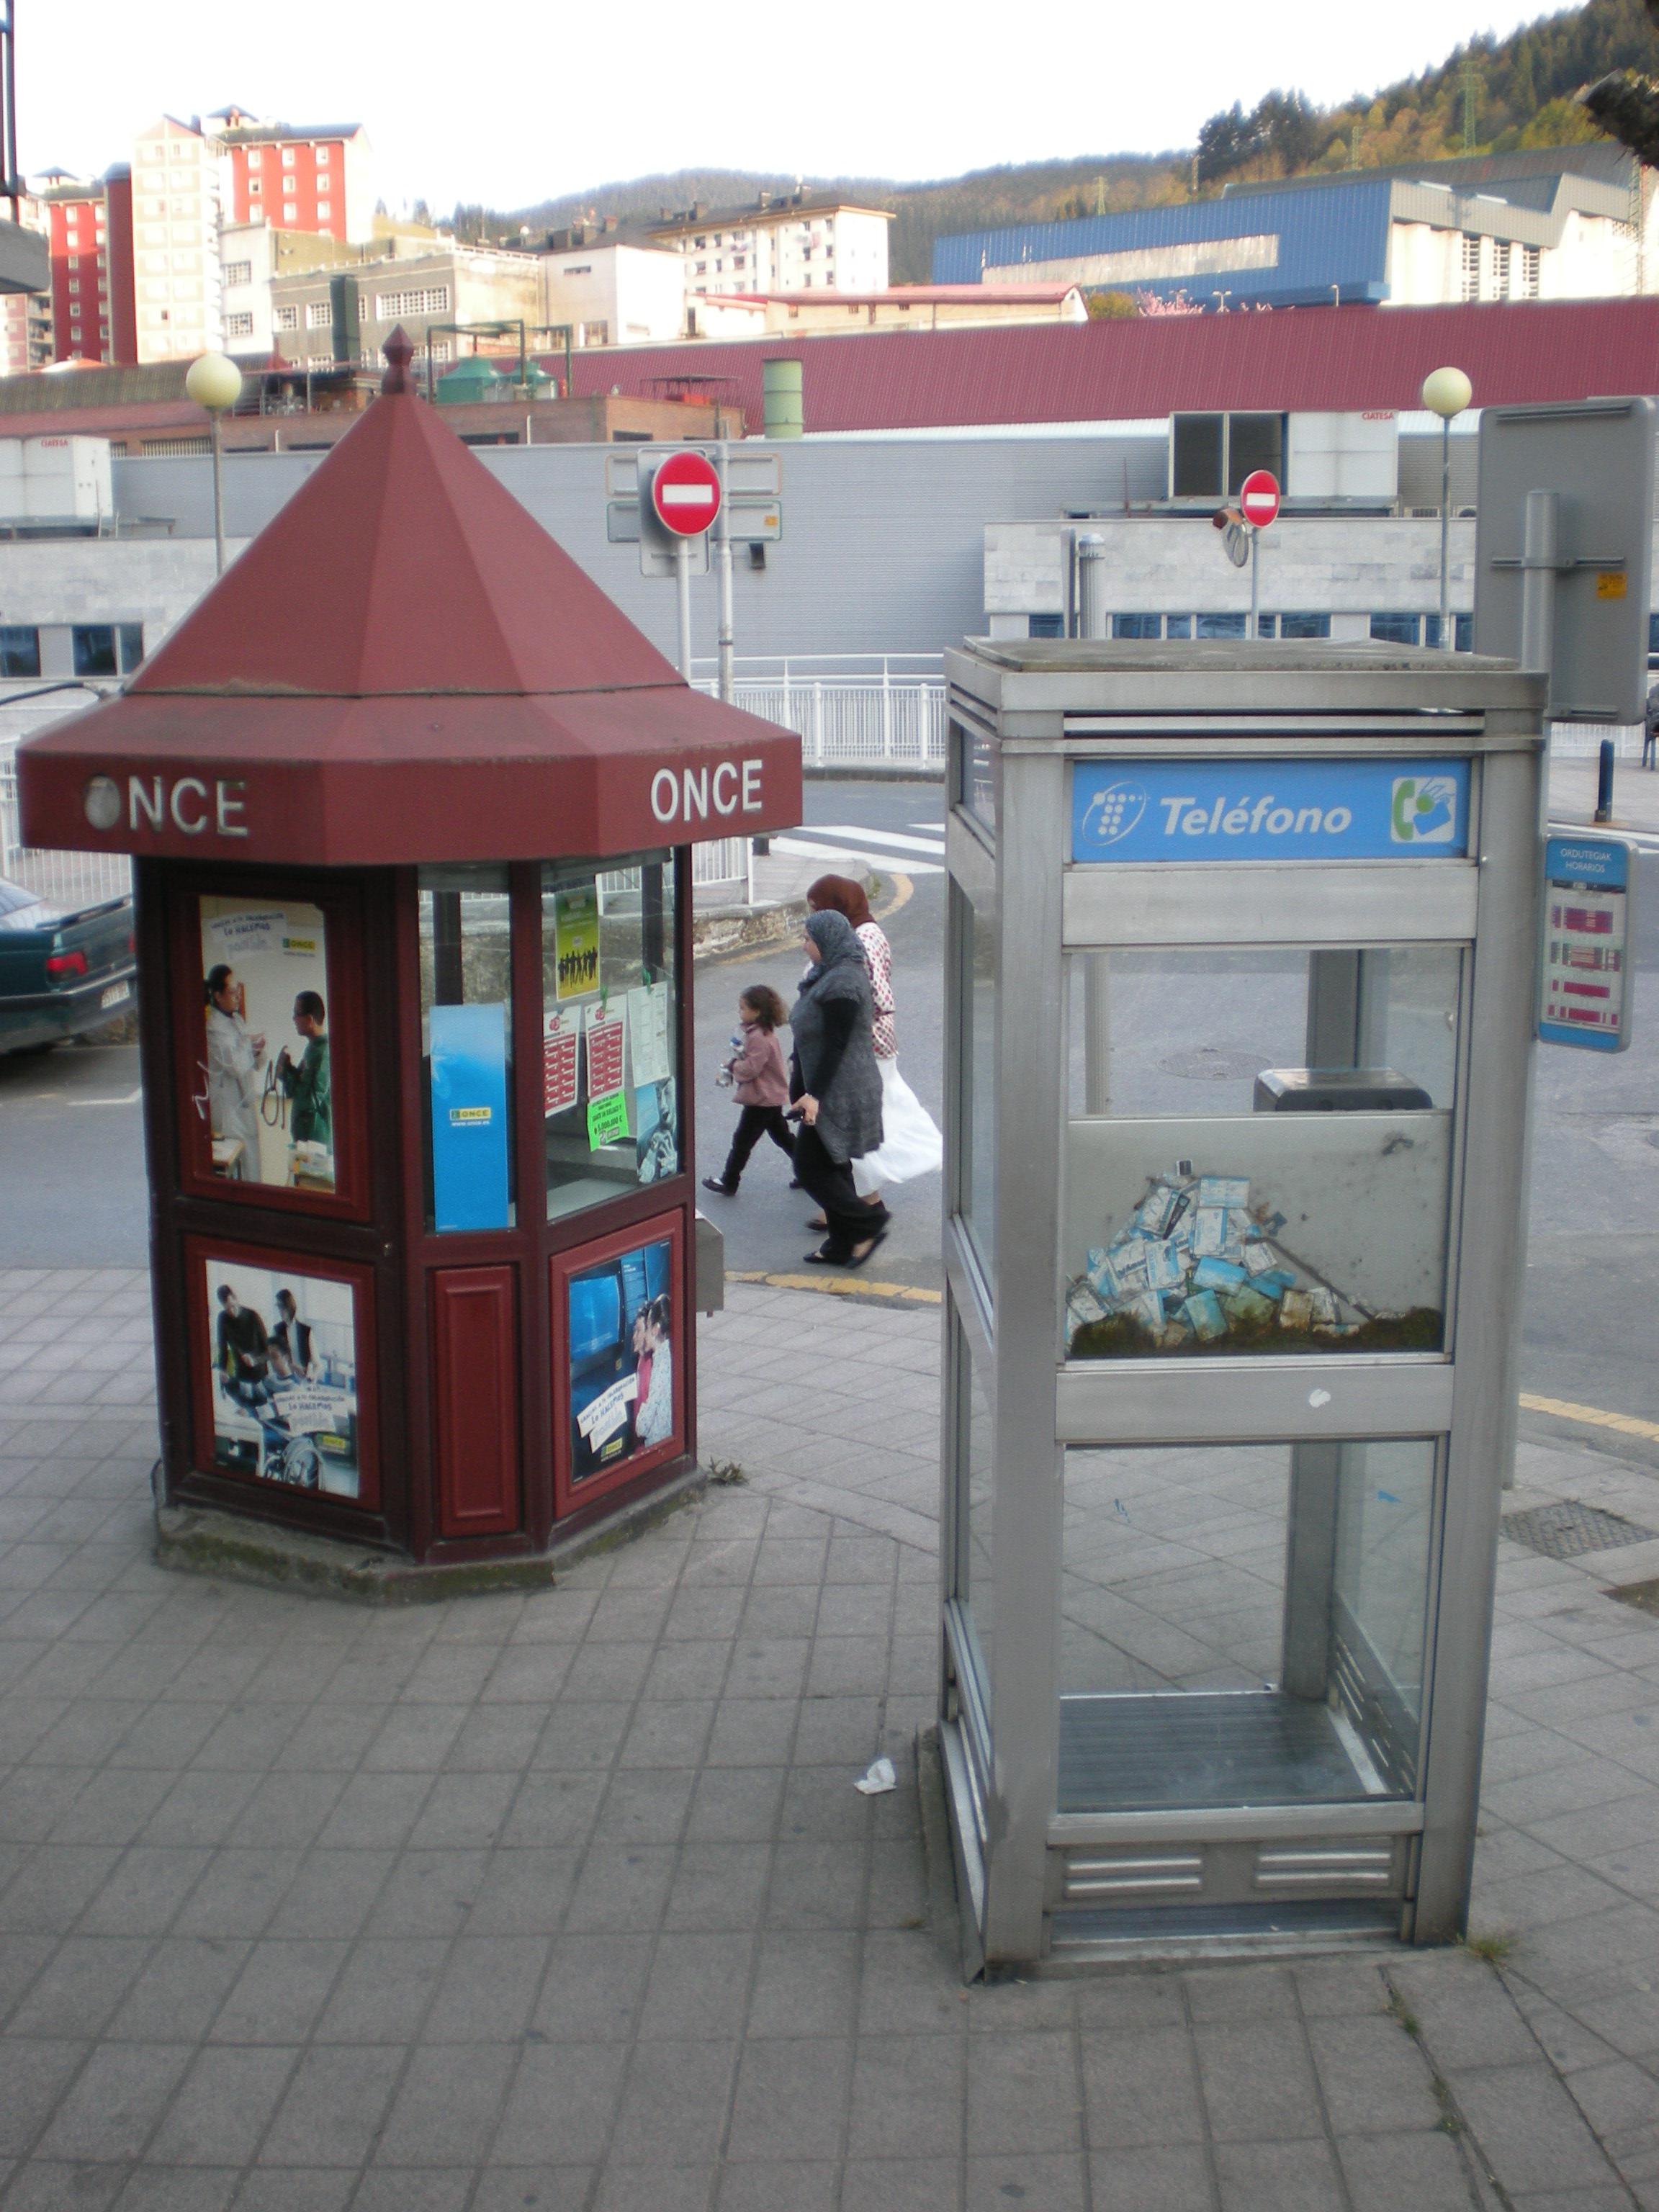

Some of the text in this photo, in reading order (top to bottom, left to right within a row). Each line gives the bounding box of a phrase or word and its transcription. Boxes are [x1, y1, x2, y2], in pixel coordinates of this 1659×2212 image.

[1362, 411, 1394, 420] CIATESA
[651, 760, 763, 822] ONCE
[1160, 795, 1352, 835] Teléfono
[1560, 848, 1612, 861] ORDUTEGIAK
[1565, 860, 1606, 873] HORARIOS
[462, 1110, 490, 1118] ONCE
